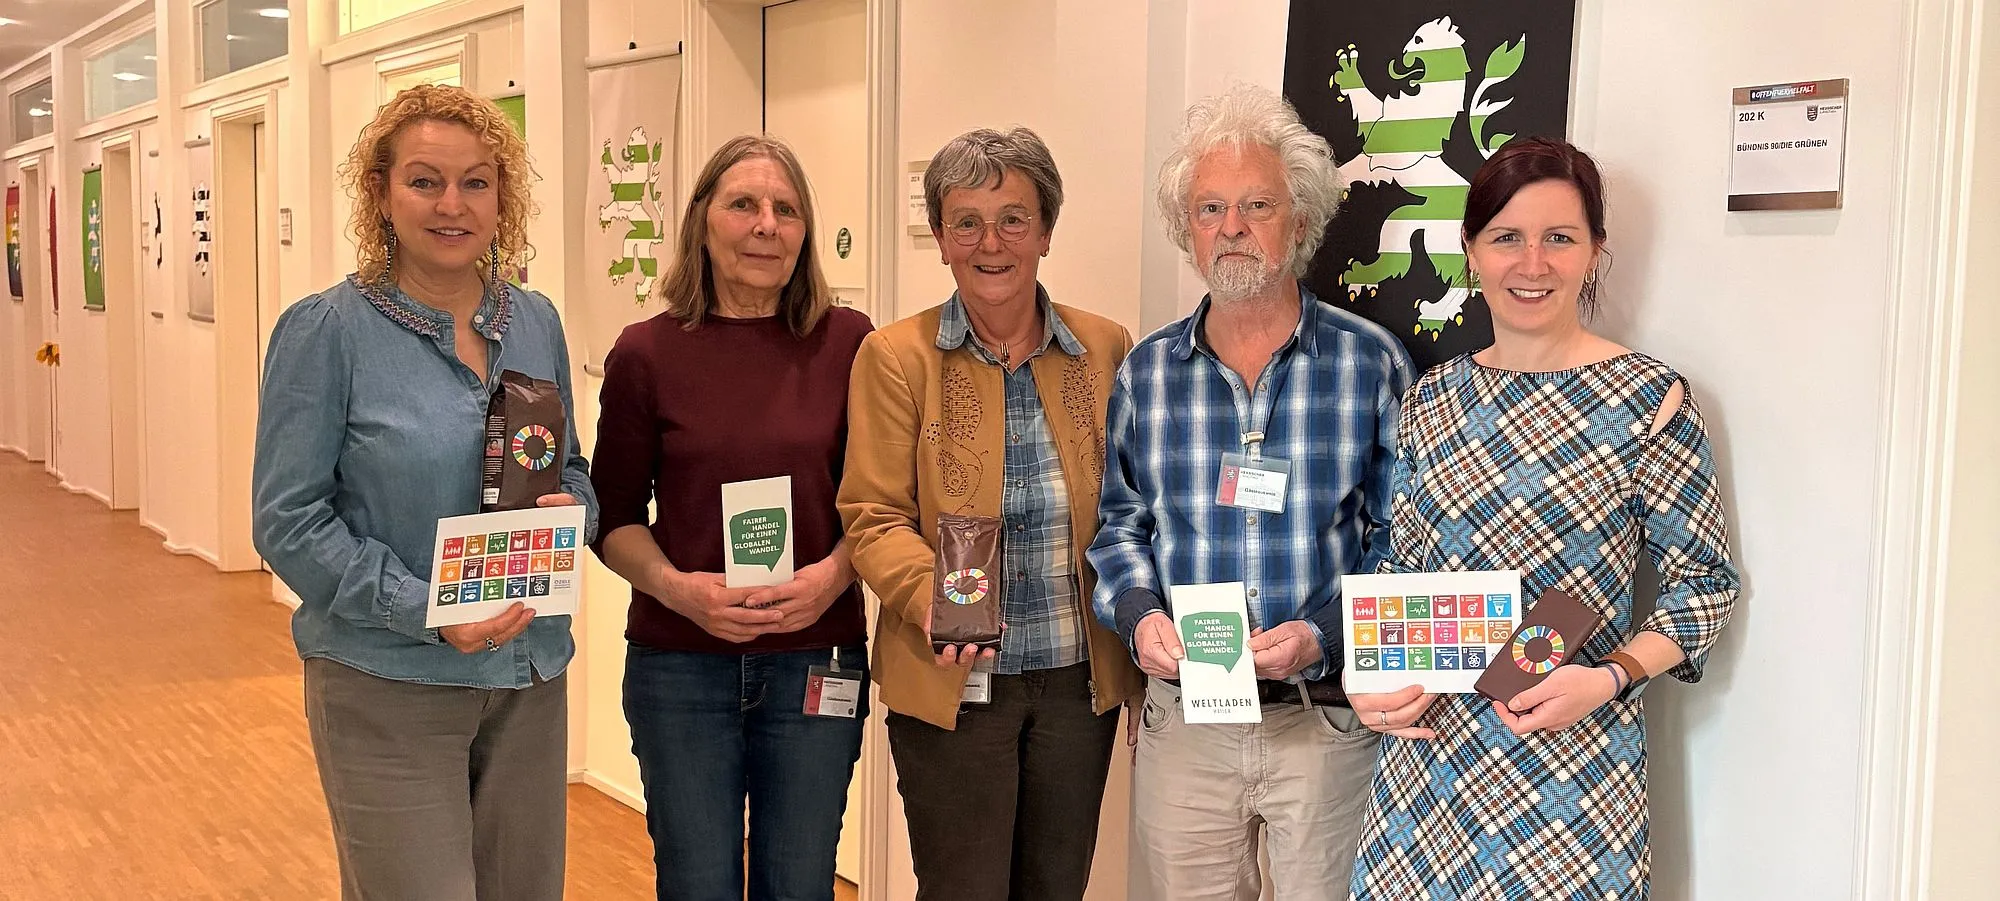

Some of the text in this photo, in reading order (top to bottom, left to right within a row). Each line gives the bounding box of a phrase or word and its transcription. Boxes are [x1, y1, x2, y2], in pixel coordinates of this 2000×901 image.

[1739, 111, 1765, 122] 202 K
[1736, 139, 1828, 151] BÜNDNIS 90/DIE GRÜNEN
[742, 517, 767, 525] FAIRER
[752, 522, 780, 530] HANDEL
[741, 529, 777, 540] FÜR EINEN
[734, 539, 771, 549] GLOBALEN
[749, 546, 780, 554] WANDEL.
[1193, 631, 1209, 639] FÜR
[1191, 698, 1252, 708] WELTLADEN
